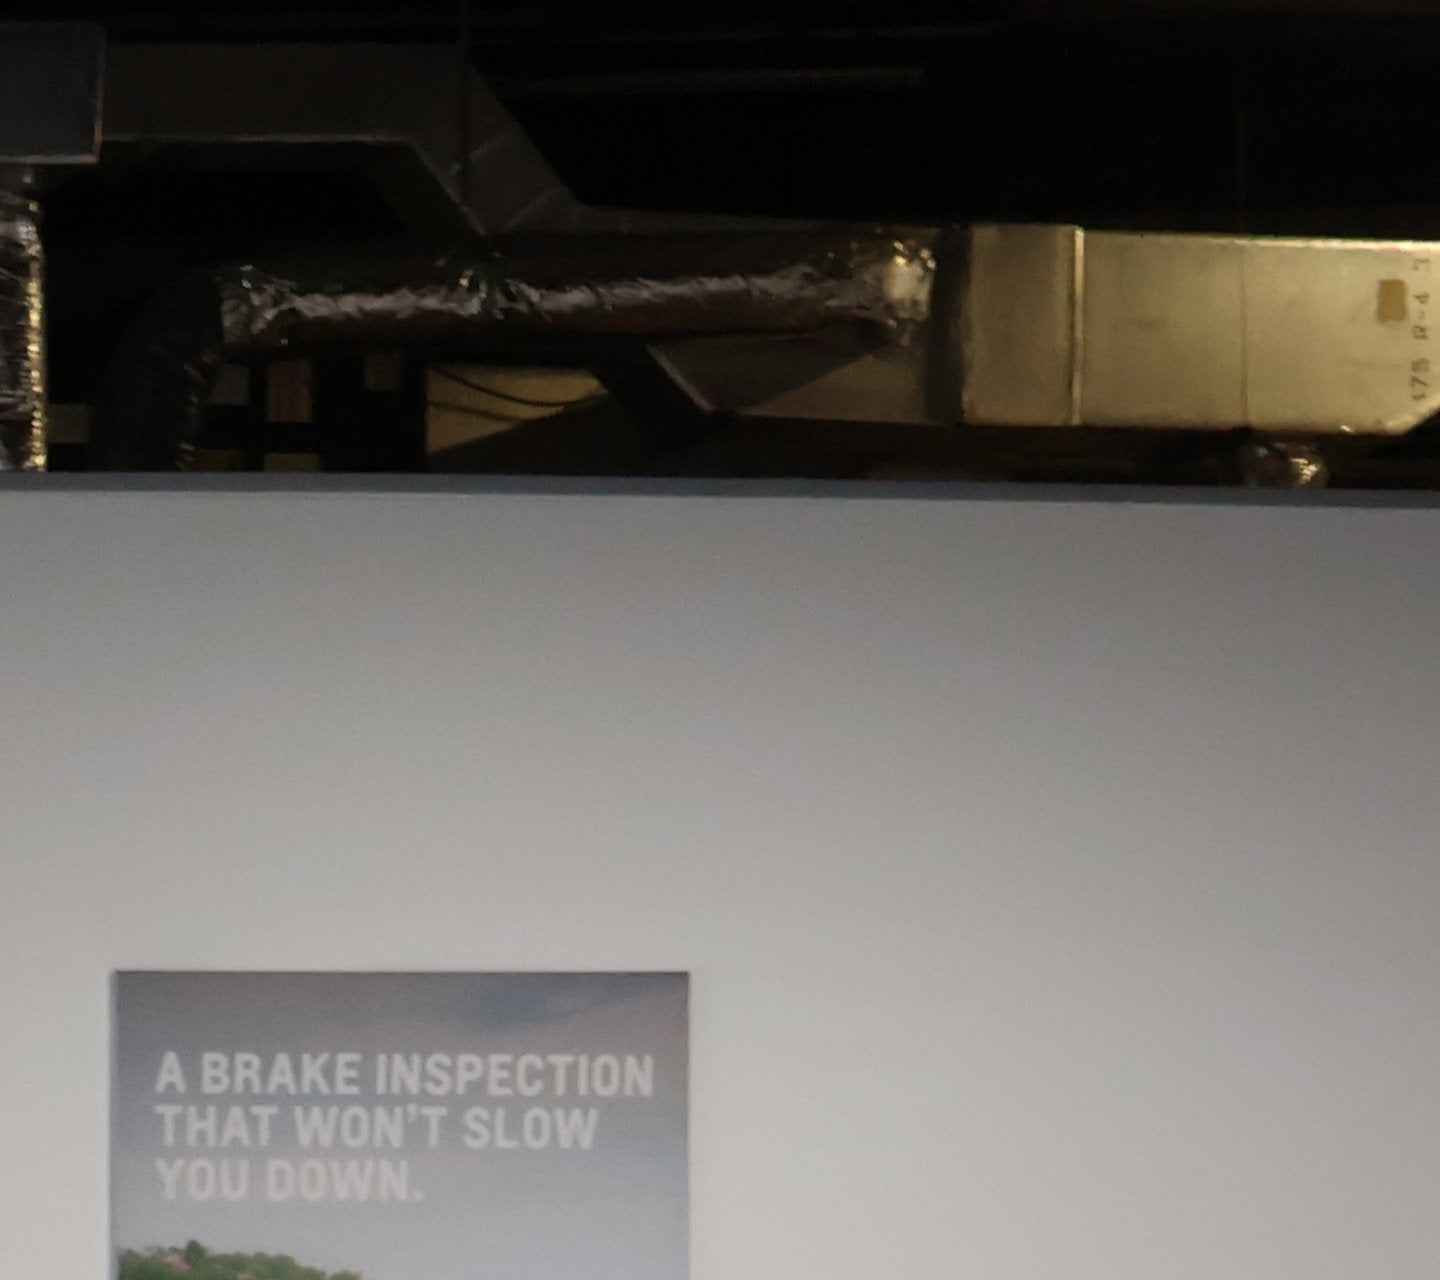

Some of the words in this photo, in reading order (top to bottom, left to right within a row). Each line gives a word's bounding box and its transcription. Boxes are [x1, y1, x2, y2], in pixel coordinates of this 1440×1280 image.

[154, 1051, 186, 1096] A
[199, 1052, 362, 1096] BRAKE
[375, 1053, 654, 1098] INSPECTION
[154, 1104, 279, 1149] THAT
[293, 1104, 448, 1149] WON'T
[463, 1106, 598, 1150] SLOW
[155, 1158, 248, 1201] YOU
[266, 1158, 424, 1202] DOWN.
